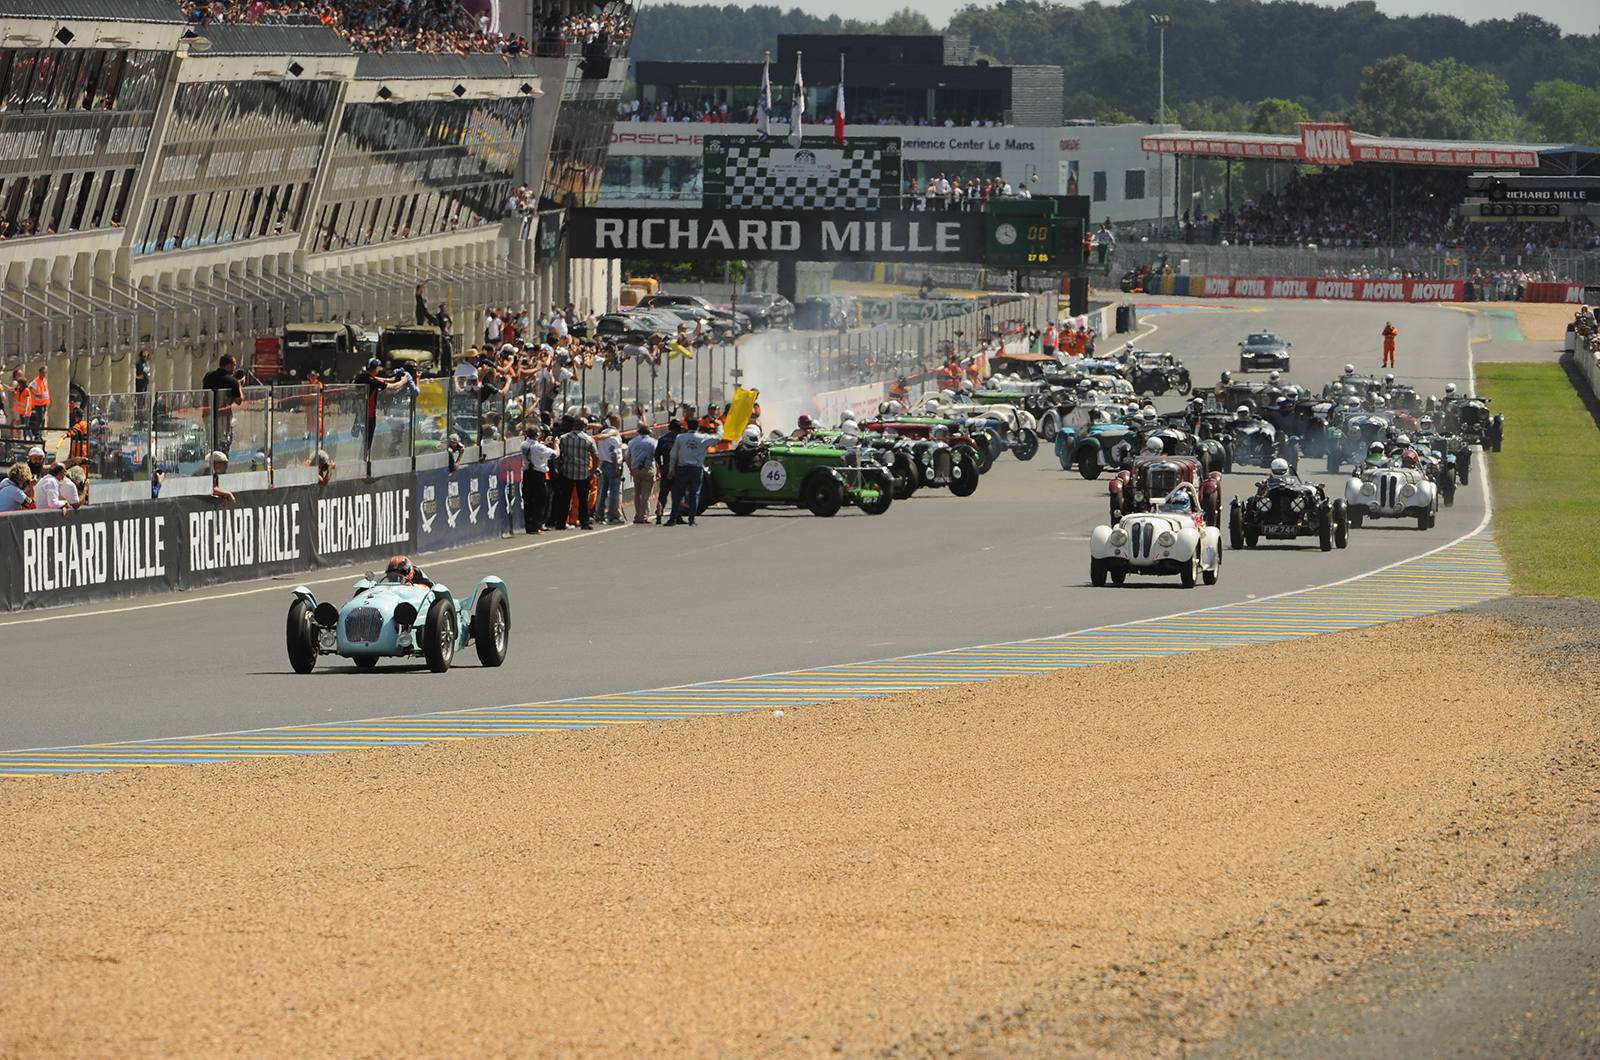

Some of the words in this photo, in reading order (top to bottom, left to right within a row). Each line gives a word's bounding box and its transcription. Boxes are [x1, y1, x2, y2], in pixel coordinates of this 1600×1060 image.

[949, 139, 985, 150] Center
[988, 139, 1000, 150] Le
[1005, 139, 1035, 150] Mans
[1305, 129, 1350, 158] MOTUL
[1506, 191, 1551, 199] RICHARD
[1553, 191, 1586, 199] MILLE
[595, 218, 801, 250] RICHARD
[821, 220, 961, 252] MILLE
[1234, 280, 1266, 296] MOTUL
[1271, 280, 1309, 296] MOTUL
[1315, 281, 1354, 298] MOTUL
[1362, 282, 1405, 300] MOTUL
[1411, 283, 1456, 300] MOTUL
[766, 470, 780, 481] 46
[317, 493, 373, 555] RICHARD
[375, 488, 410, 546] MILLE
[1263, 525, 1279, 533] FMF
[1280, 526, 1295, 534] 744
[189, 507, 254, 572] RICHARD
[258, 502, 301, 564] MILLE
[23, 521, 107, 593] RICHARD
[113, 516, 165, 581] MILLE
